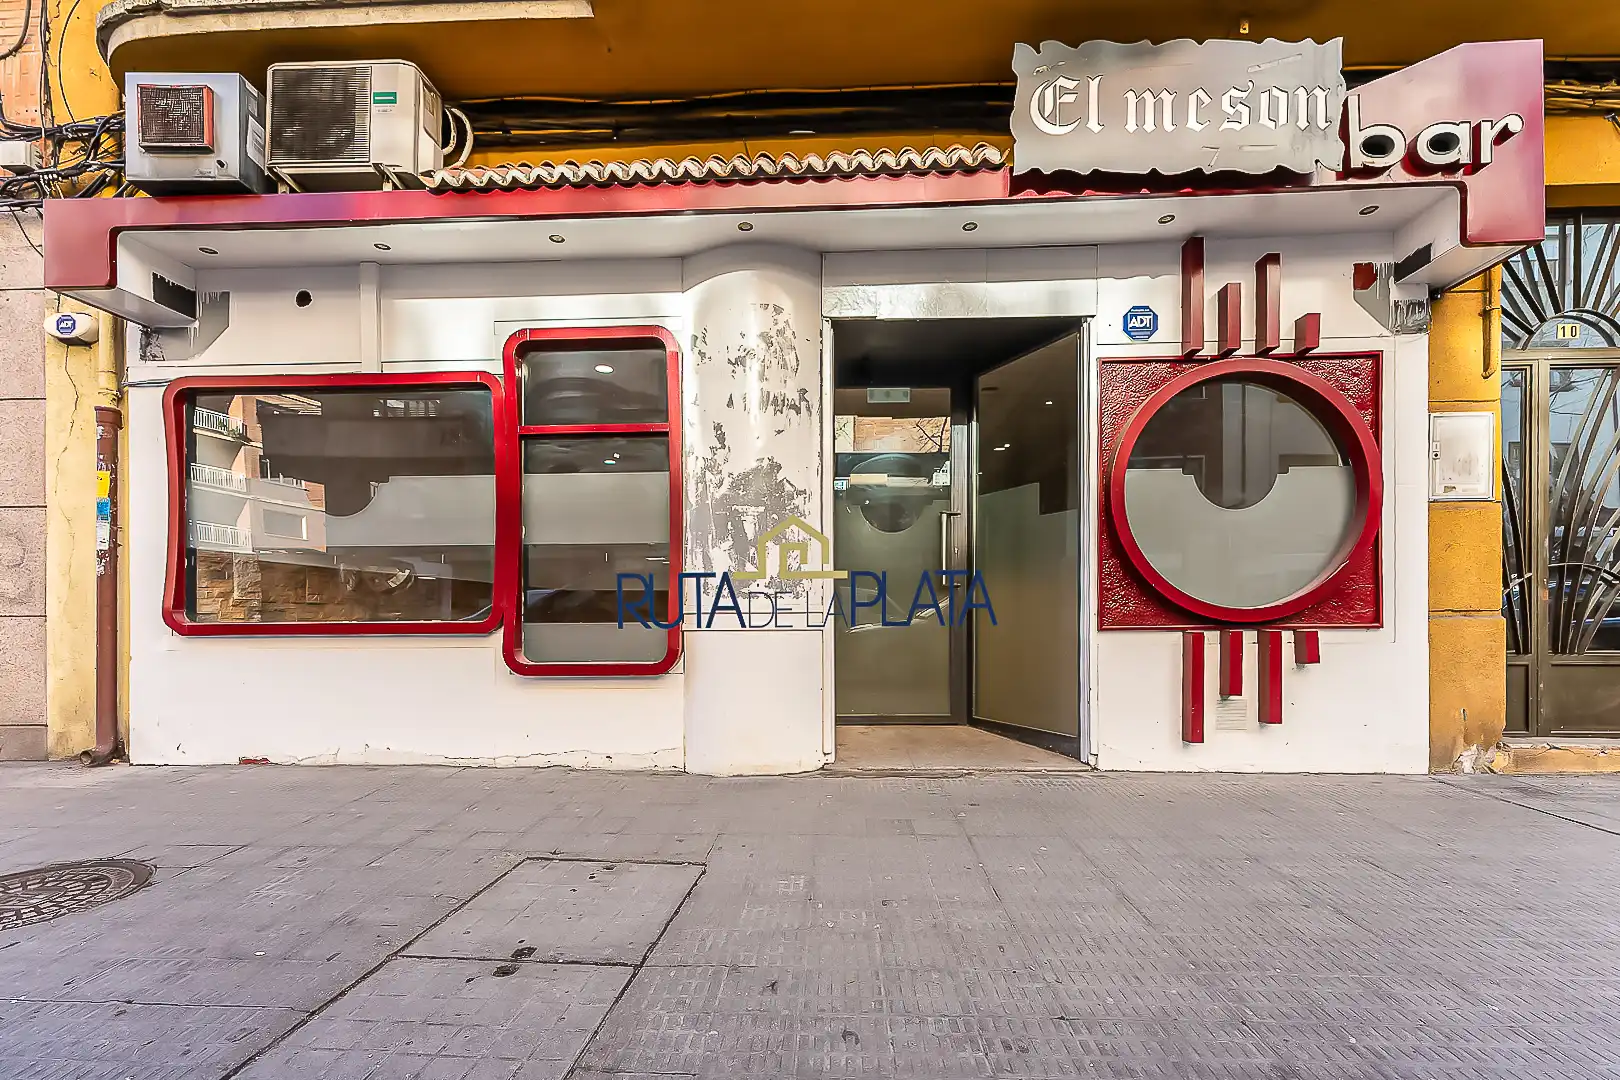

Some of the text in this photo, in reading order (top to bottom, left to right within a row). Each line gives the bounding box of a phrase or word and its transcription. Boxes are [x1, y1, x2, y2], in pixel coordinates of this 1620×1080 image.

[1029, 74, 1333, 135] El meson
[1347, 94, 1525, 169] bar
[59, 320, 74, 328] ADT
[1128, 315, 1152, 328] ADT
[1560, 325, 1577, 338] 10
